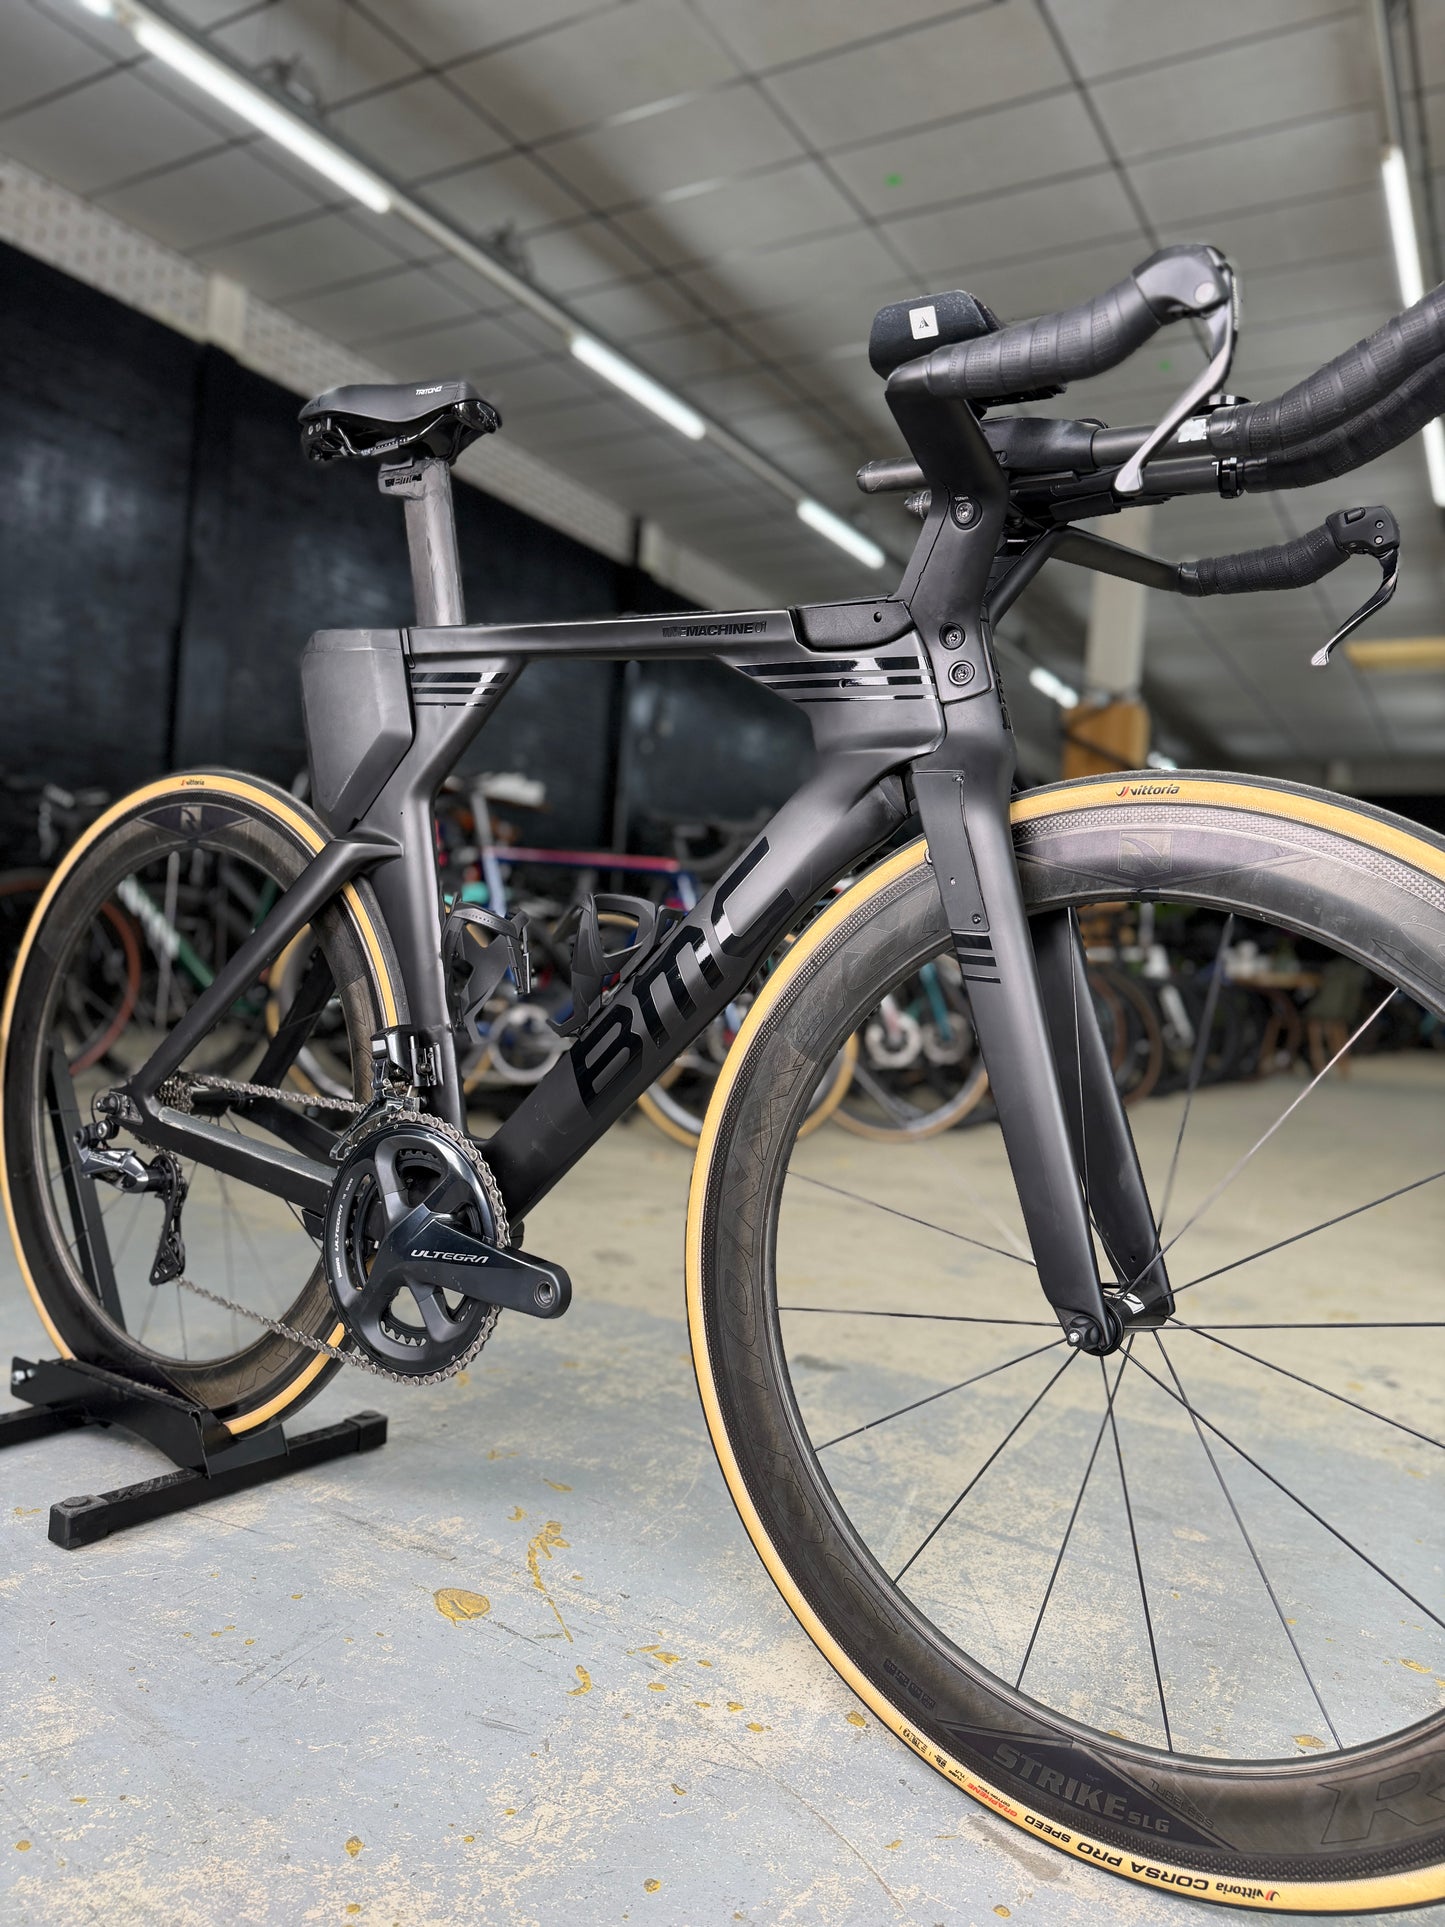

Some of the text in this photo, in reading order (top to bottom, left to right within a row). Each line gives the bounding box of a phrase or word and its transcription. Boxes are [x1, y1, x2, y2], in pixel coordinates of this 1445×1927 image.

[1130, 783, 1181, 796] vittoria
[569, 836, 796, 1113] BMC
[410, 1249, 490, 1265] ULTEGRA
[966, 1782, 1018, 1818] GRAPHENE
[991, 1743, 1171, 1834] STRIKE SLG
[1023, 1814, 1264, 1900] vittoria CORSA PRO SPEED
